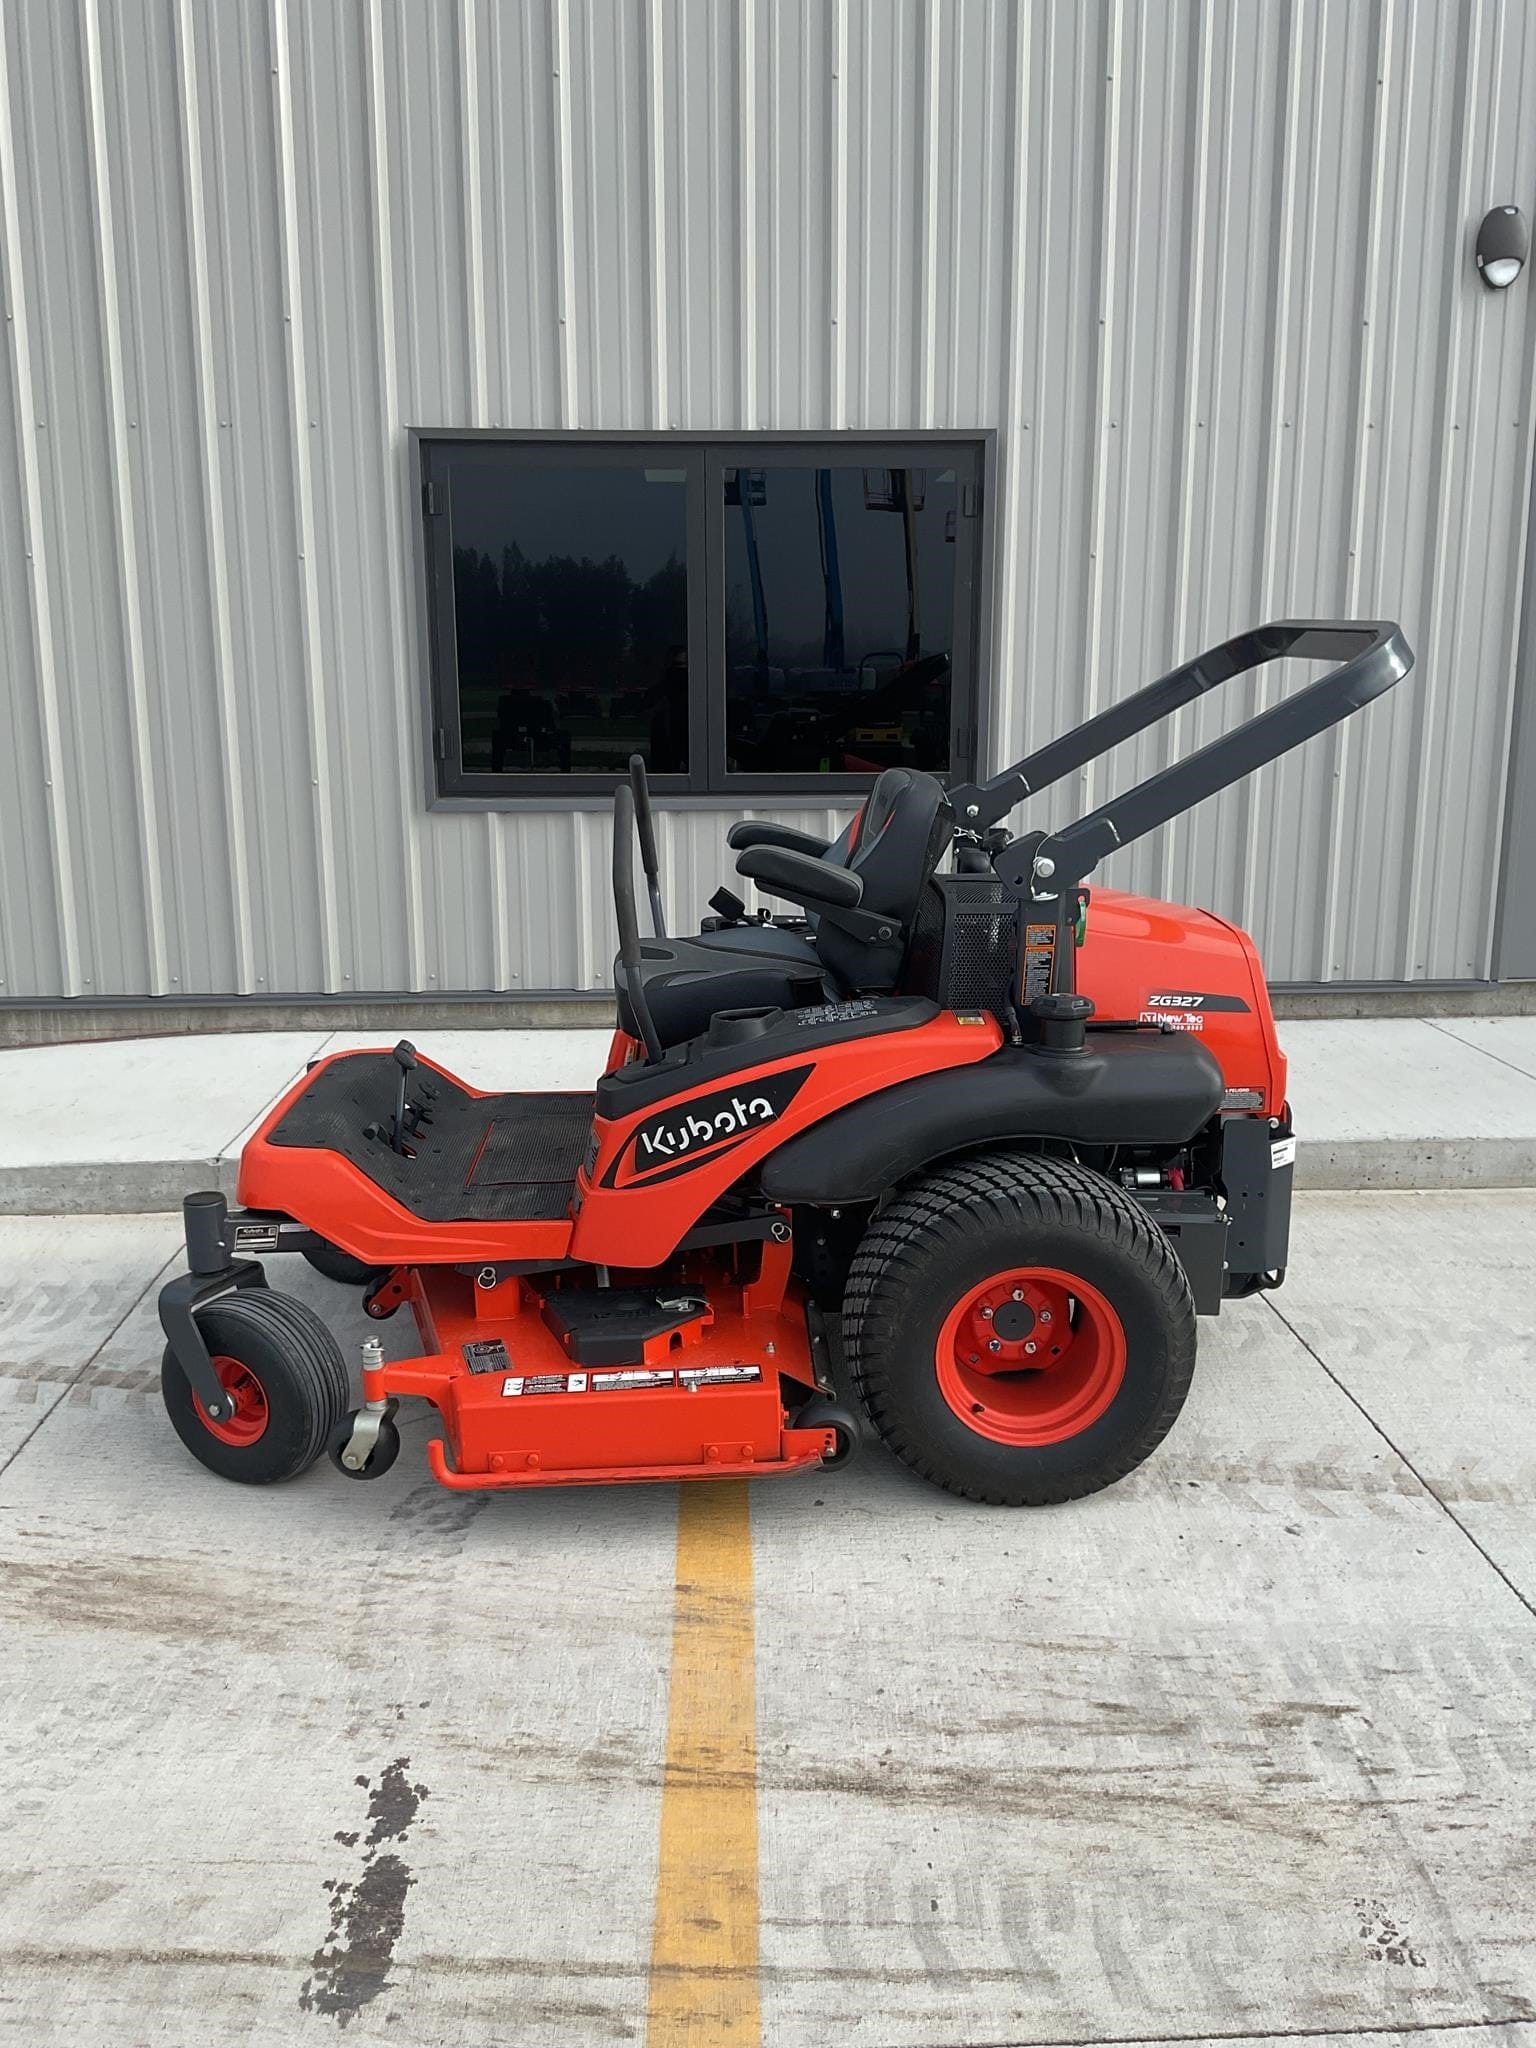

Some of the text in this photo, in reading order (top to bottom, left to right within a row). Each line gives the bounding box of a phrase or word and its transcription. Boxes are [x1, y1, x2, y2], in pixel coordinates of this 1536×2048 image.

[1148, 995, 1204, 1007] ZG327
[1158, 1012, 1183, 1022] New
[1184, 1013, 1204, 1022] Tec
[641, 1098, 773, 1155] Kubota
